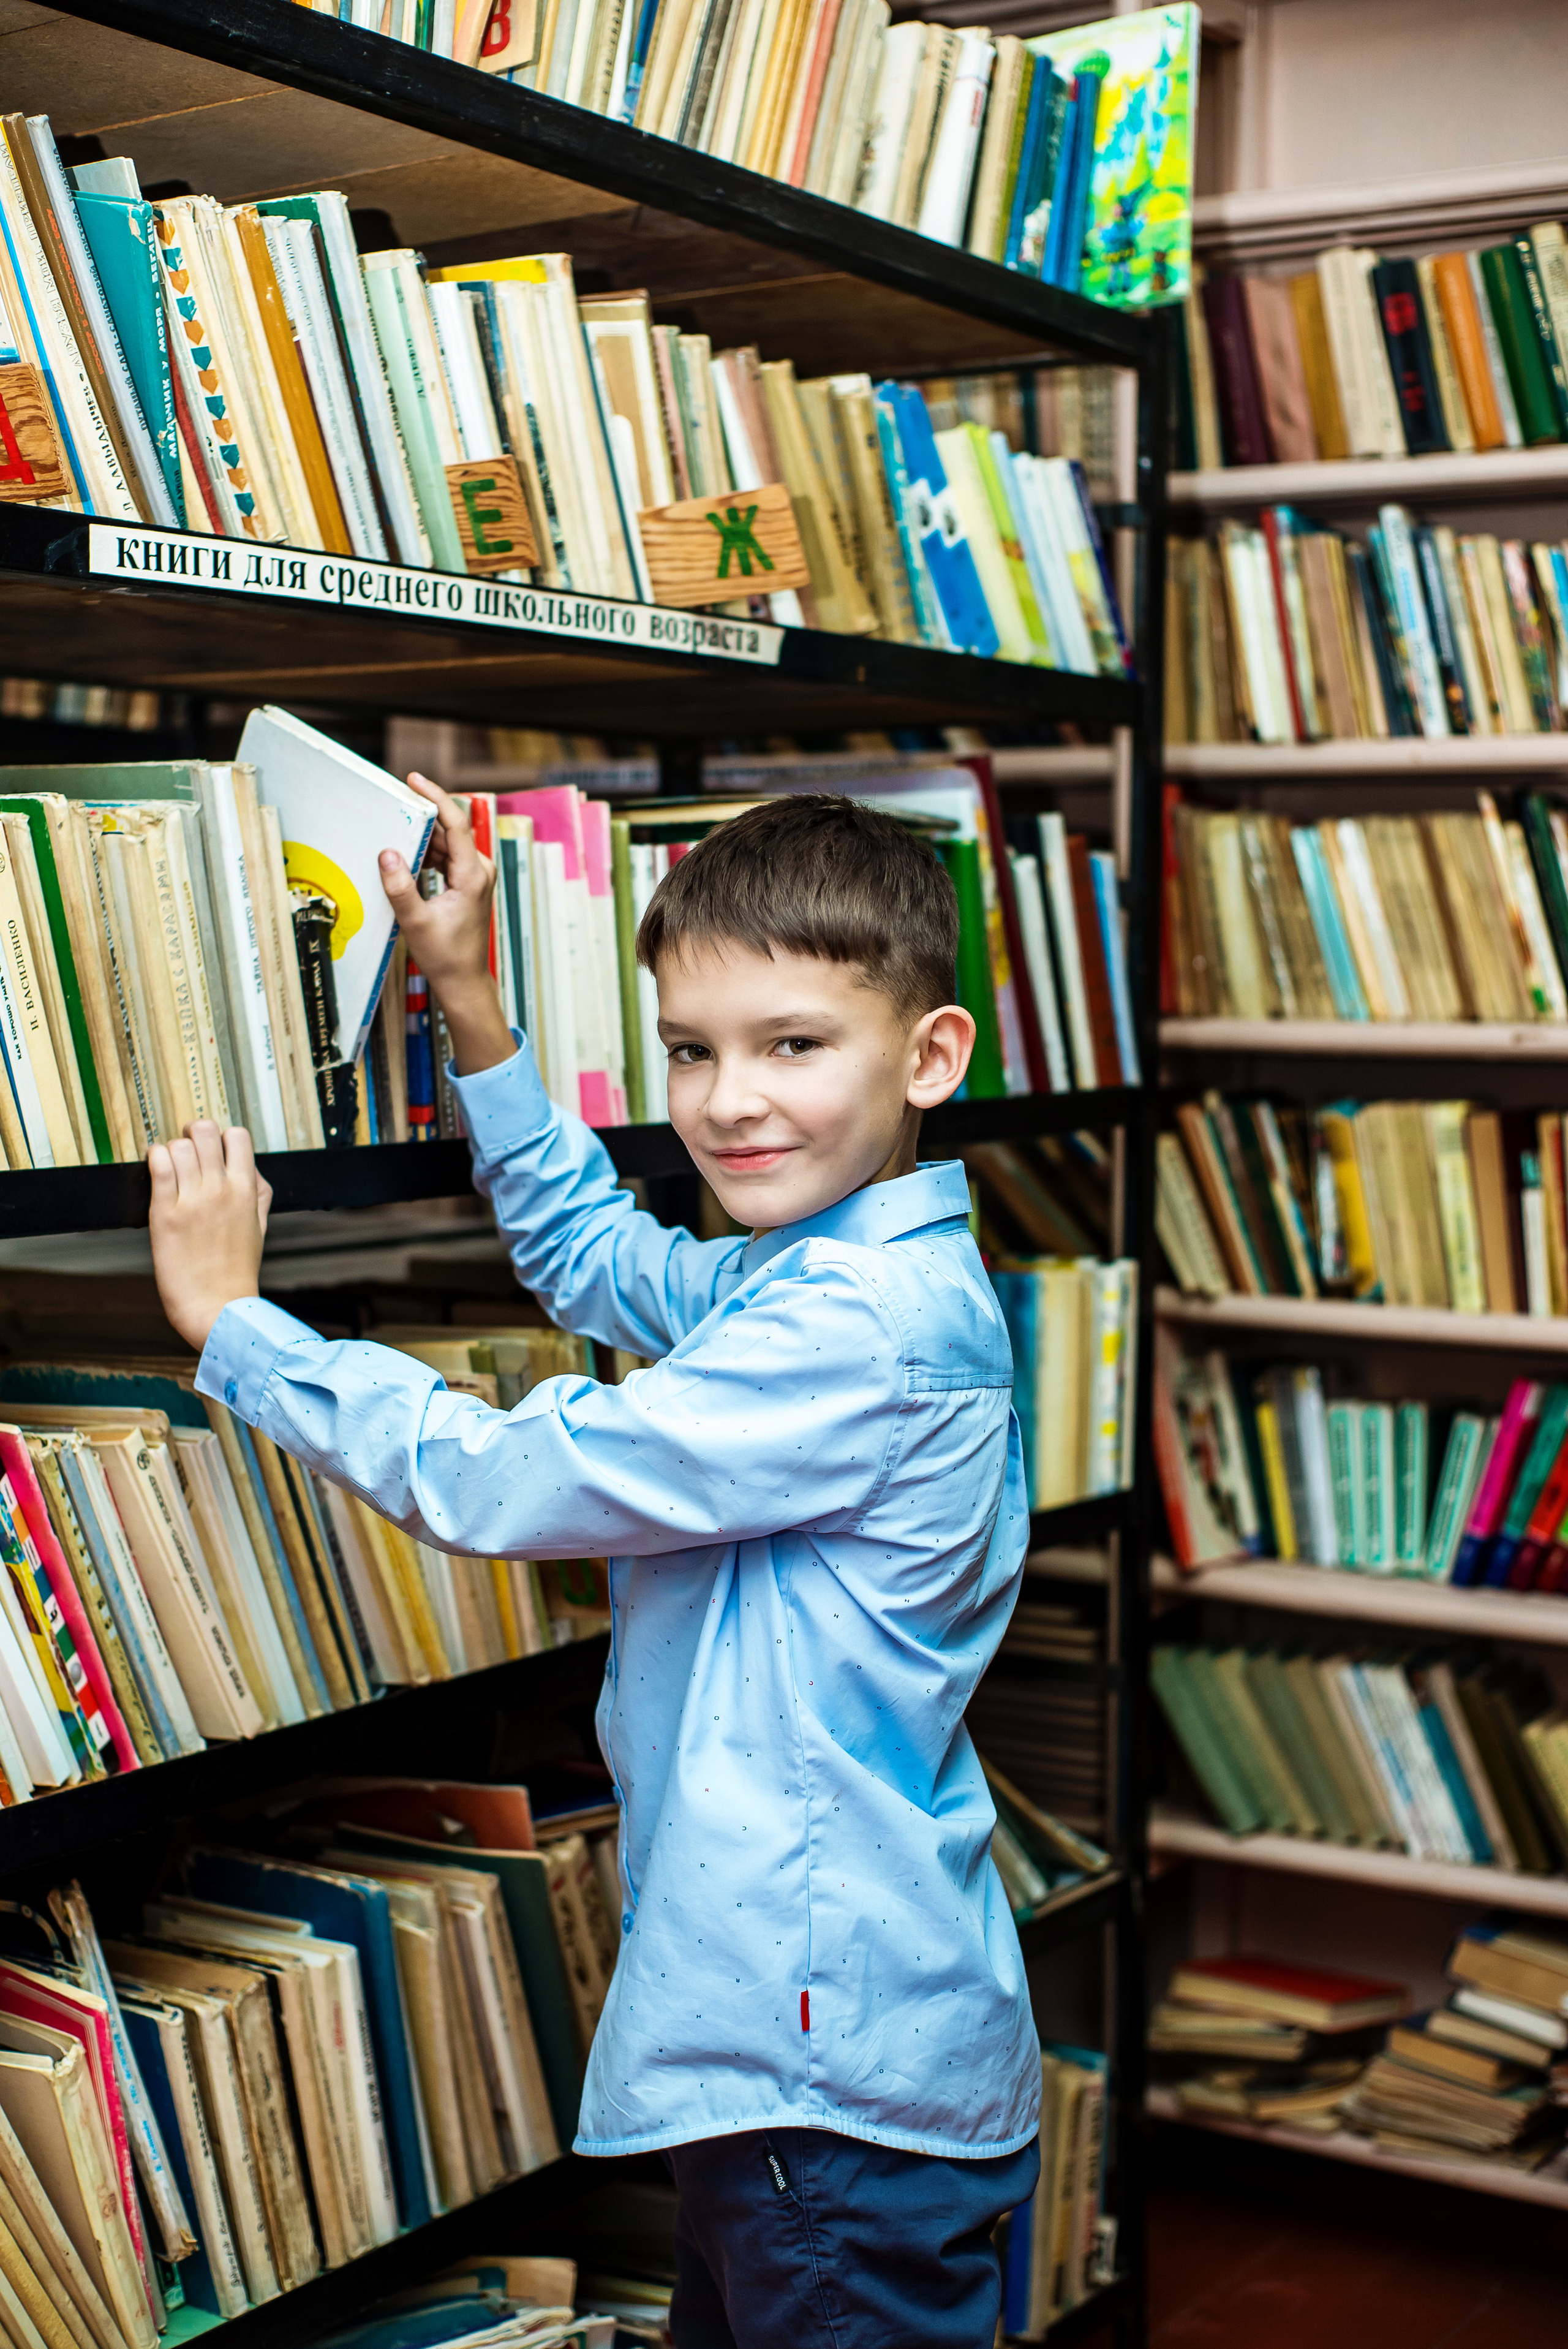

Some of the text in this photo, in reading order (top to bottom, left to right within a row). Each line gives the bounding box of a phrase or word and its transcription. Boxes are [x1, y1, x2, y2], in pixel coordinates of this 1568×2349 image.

[145, 218, 158, 283] БЕГЛЕЦ
[154, 306, 167, 353] МОРЯ
[461, 478, 513, 555] Е
[705, 504, 774, 578] Ж
[243, 554, 307, 593] для
[319, 564, 462, 611] среднего
[475, 588, 636, 636] школьного
[650, 615, 759, 653] возраста
[154, 860, 182, 961] КАРАСЯМИ
[244, 906, 258, 948] ПЯТОГО
[7, 918, 34, 1010] ВАСИЛЕНКО
[251, 955, 265, 993] ТАЙНА
[6, 1004, 18, 1040] ХОРОШО
[175, 982, 197, 1043] КЕПКА
[768, 2155, 786, 2190] SUPER COOL
